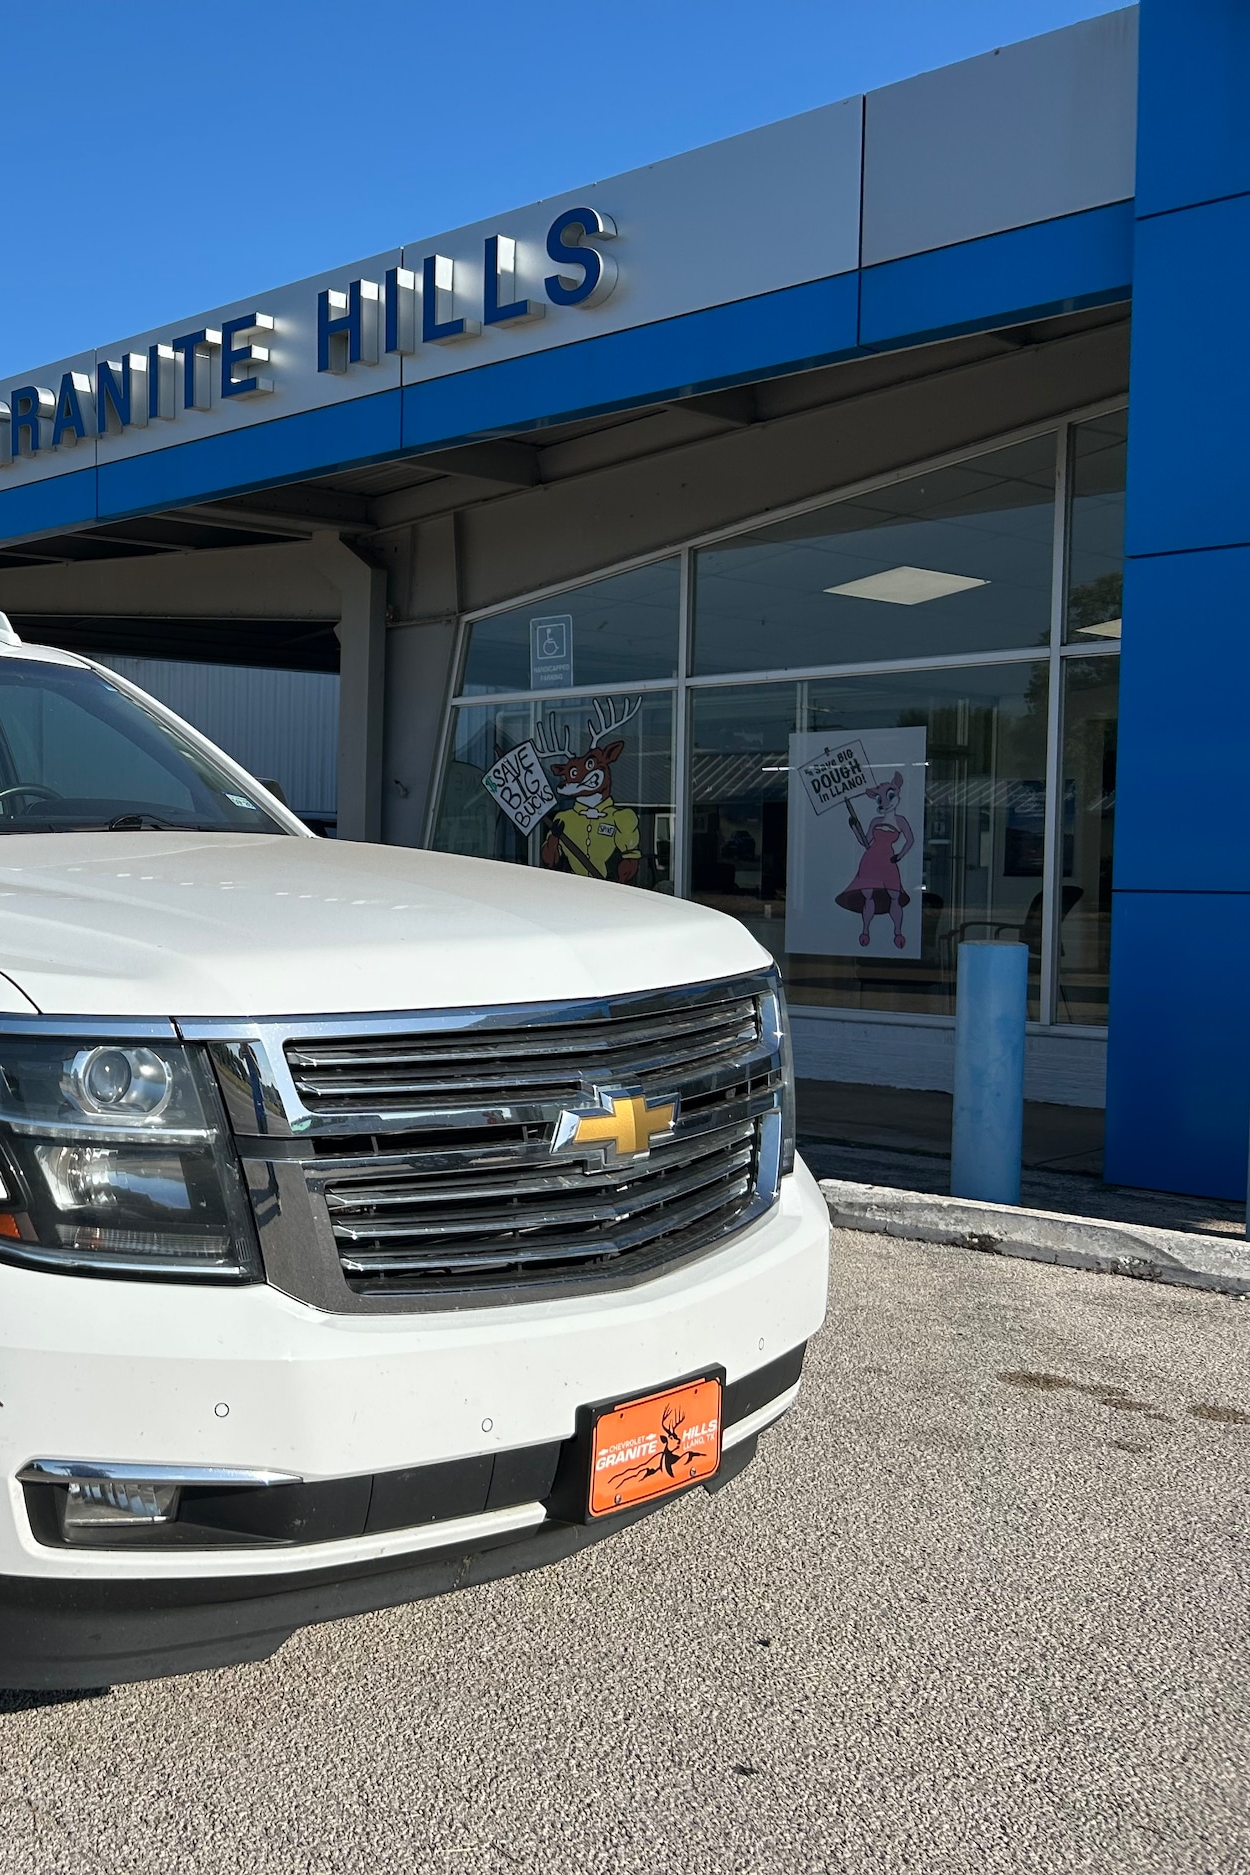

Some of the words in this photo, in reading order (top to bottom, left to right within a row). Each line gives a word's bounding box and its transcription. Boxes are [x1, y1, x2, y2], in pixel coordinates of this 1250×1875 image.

[317, 207, 618, 375] HILLS
[540, 673, 563, 681] PARKING
[492, 746, 535, 788] SAVE
[837, 749, 854, 763] BIG
[500, 769, 540, 810] BIG
[811, 758, 862, 794] DOUGH
[830, 773, 867, 798] LLANO!
[514, 784, 554, 828] BUCKS
[609, 1435, 646, 1452] CHEVROLET
[682, 1419, 717, 1442] HILLS
[683, 1436, 705, 1450] LLANO,
[706, 1432, 715, 1442] TX
[595, 1440, 658, 1471] GRANITE
